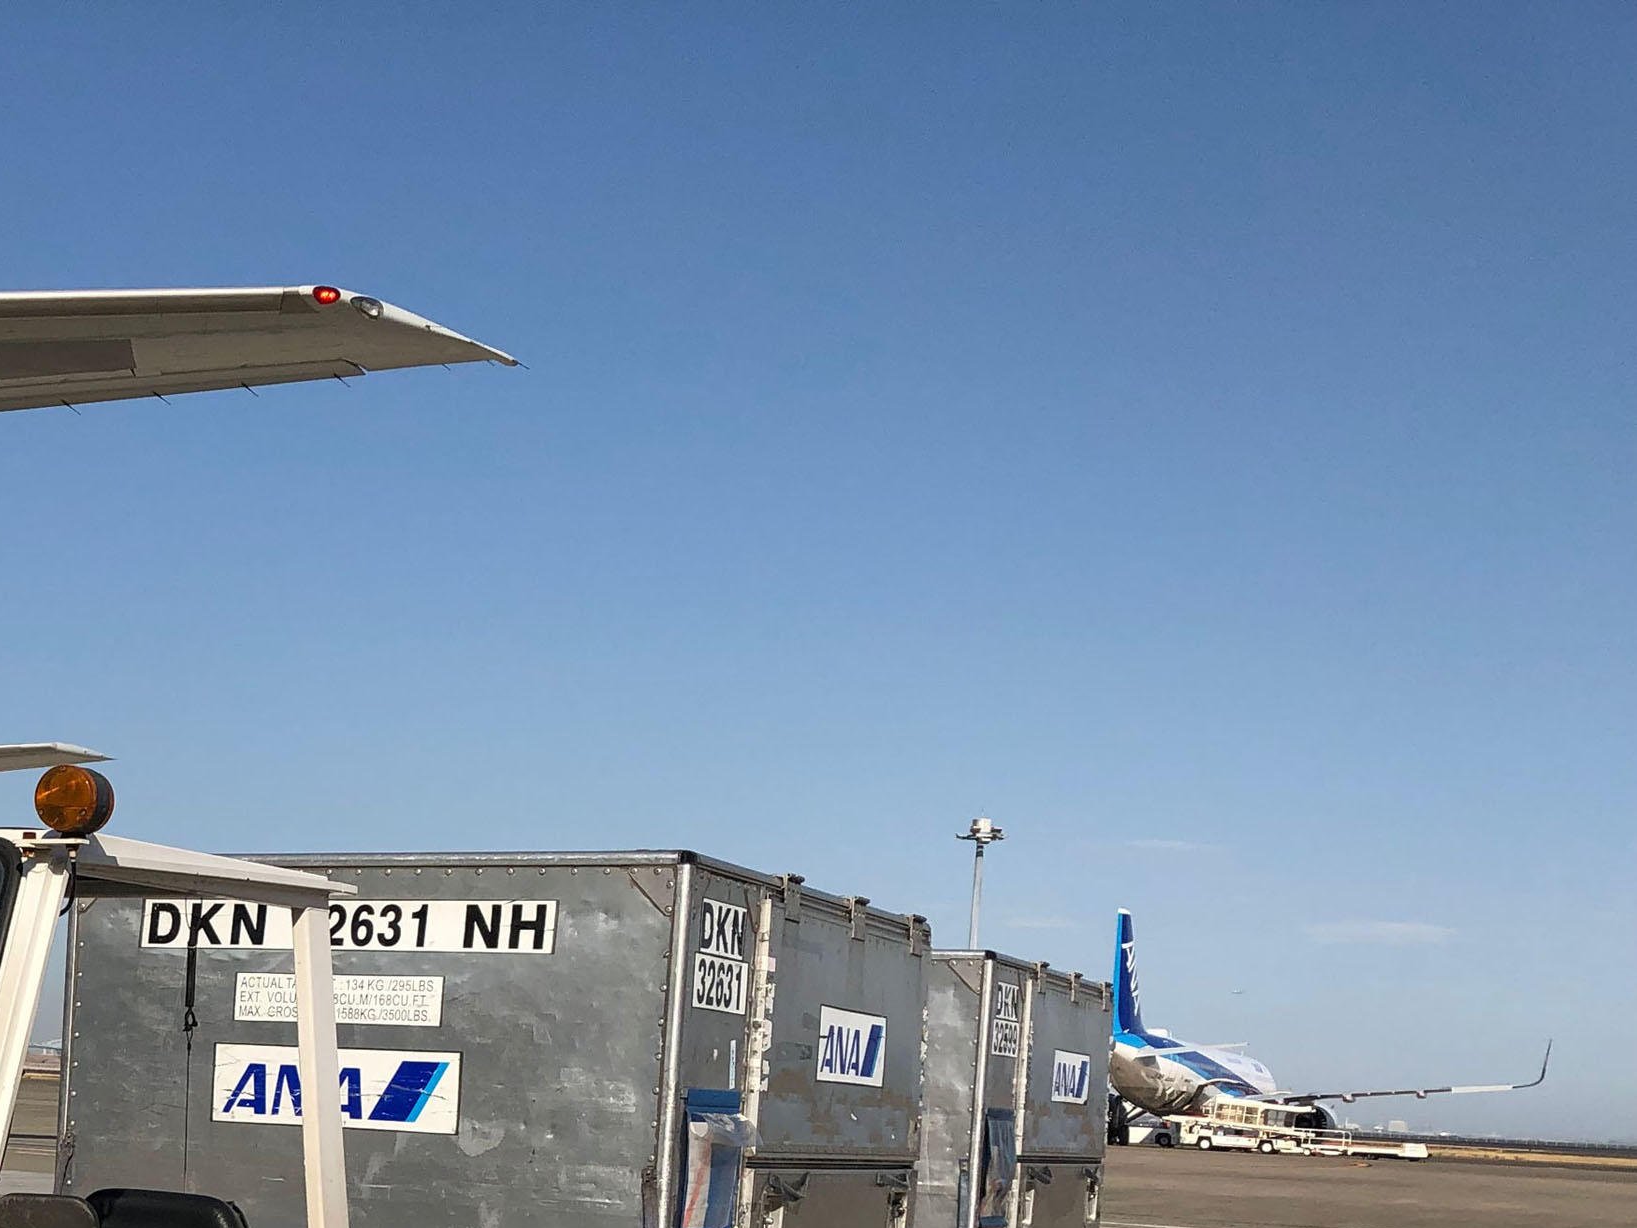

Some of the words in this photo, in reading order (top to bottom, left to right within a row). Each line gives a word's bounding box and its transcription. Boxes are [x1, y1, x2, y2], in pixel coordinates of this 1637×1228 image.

[148, 902, 268, 946] DKN
[329, 904, 429, 948] 2631
[463, 904, 547, 950] NH
[699, 902, 747, 957] DKN
[241, 977, 283, 988] ACTUAL
[267, 991, 297, 1004] VOLU
[697, 958, 743, 1011] 32631
[267, 1006, 298, 1018] GROS
[996, 984, 1018, 1018] DKN
[820, 1025, 861, 1077] ANA
[1054, 1062, 1077, 1098] ANA
